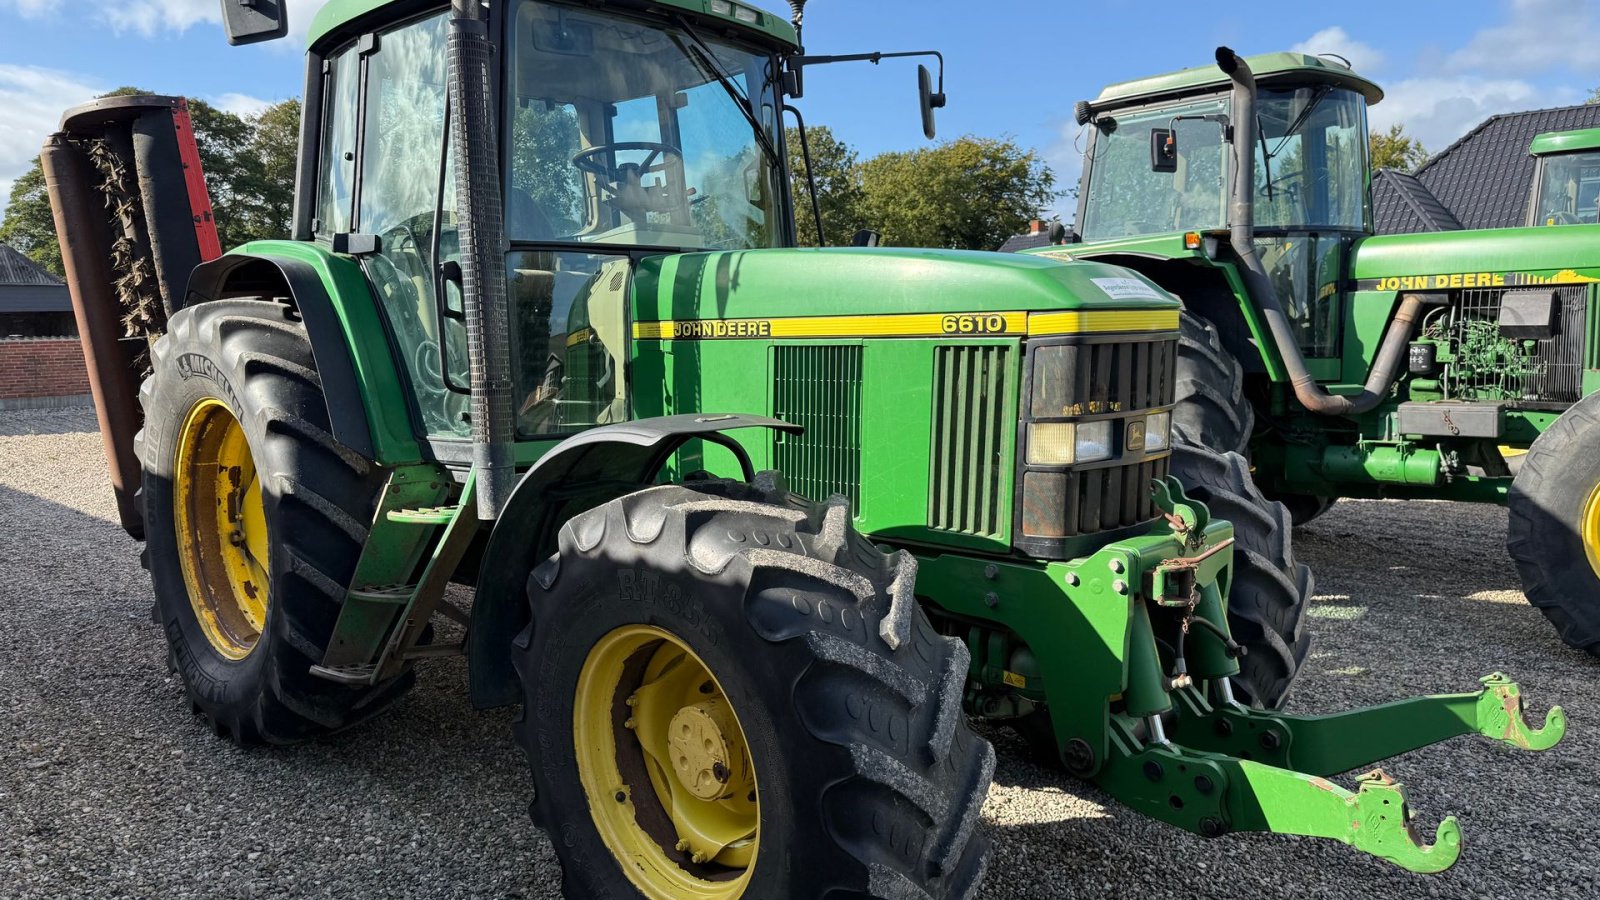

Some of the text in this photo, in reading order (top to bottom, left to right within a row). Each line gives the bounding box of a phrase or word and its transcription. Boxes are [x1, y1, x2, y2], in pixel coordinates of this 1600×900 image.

[1376, 273, 1505, 291] JOHN DEERE
[674, 321, 771, 337] JOHN DEERE
[942, 314, 1007, 333] 6610
